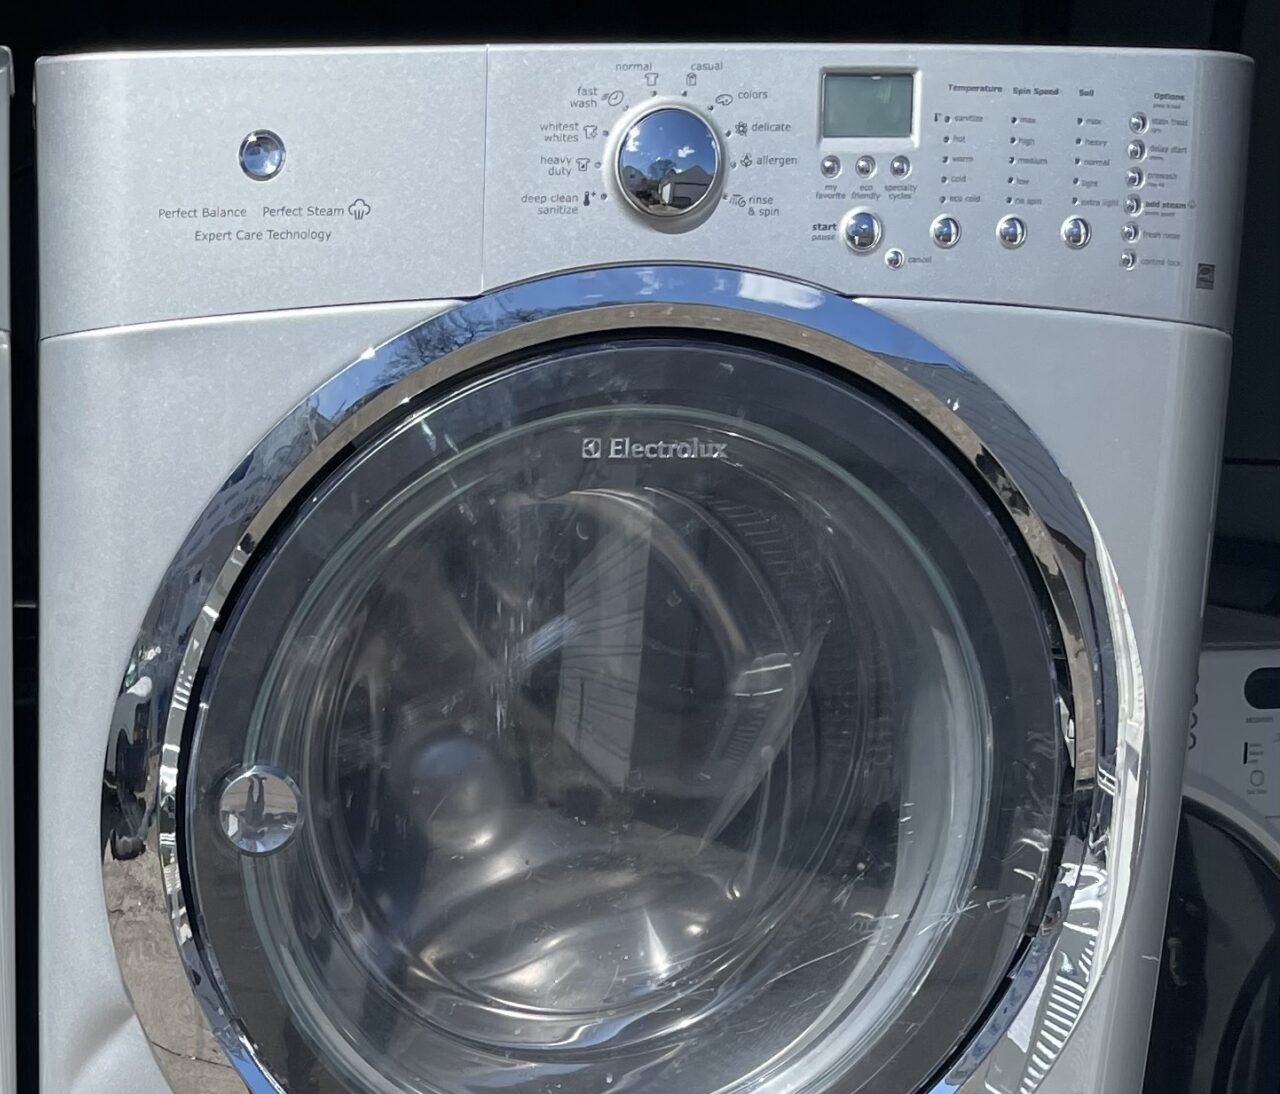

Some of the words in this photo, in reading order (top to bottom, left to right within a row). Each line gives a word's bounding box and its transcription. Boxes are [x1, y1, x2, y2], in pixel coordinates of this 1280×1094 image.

[615, 62, 652, 71] normal
[690, 62, 723, 71] casual
[577, 86, 598, 96] fast
[948, 84, 1002, 93] Temperature
[1013, 87, 1031, 95] Spin
[1034, 88, 1059, 96] Speed
[738, 90, 768, 100] colors
[570, 98, 598, 108] wash
[540, 122, 579, 132] whitest
[751, 122, 792, 132] delicate
[544, 132, 579, 142] whites
[953, 135, 965, 143] hot
[540, 155, 572, 168] heavy
[756, 156, 798, 166] allergen
[548, 166, 572, 178] duty
[825, 184, 837, 192] my
[885, 184, 917, 192] specialty
[520, 193, 548, 204] deep
[550, 193, 579, 202] clean
[748, 196, 774, 204] rinse
[851, 192, 880, 200] friendly
[888, 192, 912, 200] cycles
[159, 208, 197, 219] Perfect
[202, 207, 247, 217] Balance
[262, 206, 303, 217] Perfect
[307, 206, 344, 216] Steam
[537, 204, 579, 214] sanitize
[748, 206, 756, 216] &
[758, 207, 779, 218] spin
[812, 223, 837, 231] start
[194, 231, 232, 243] Expert
[236, 230, 263, 240] Care
[267, 229, 332, 241] Technology
[608, 437, 729, 459] Electrolux
